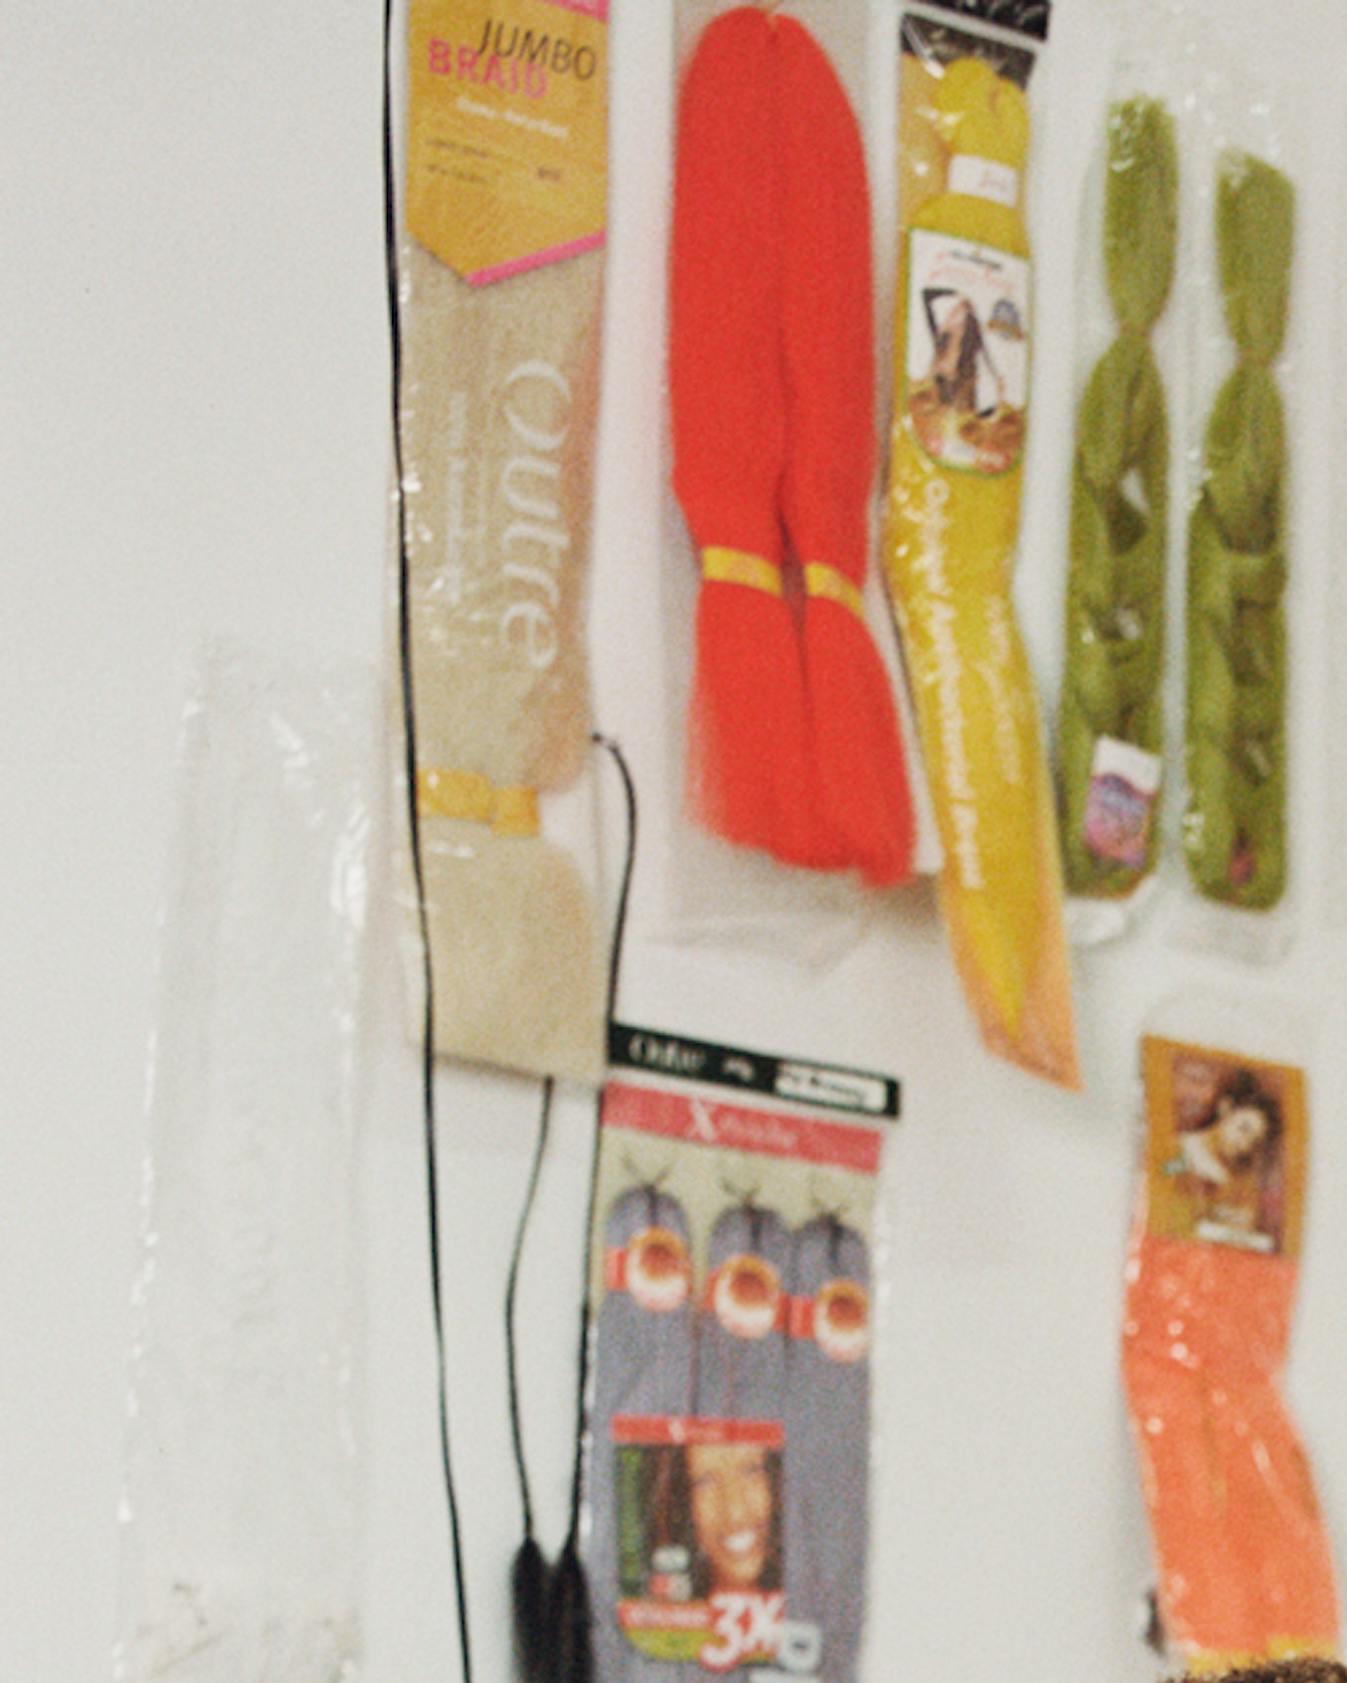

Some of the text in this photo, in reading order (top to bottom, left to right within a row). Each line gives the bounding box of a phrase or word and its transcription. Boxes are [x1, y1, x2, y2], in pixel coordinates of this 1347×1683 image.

[429, 37, 549, 99] BRAID
[479, 18, 596, 81] JUMBO
[500, 357, 573, 669] Outre
